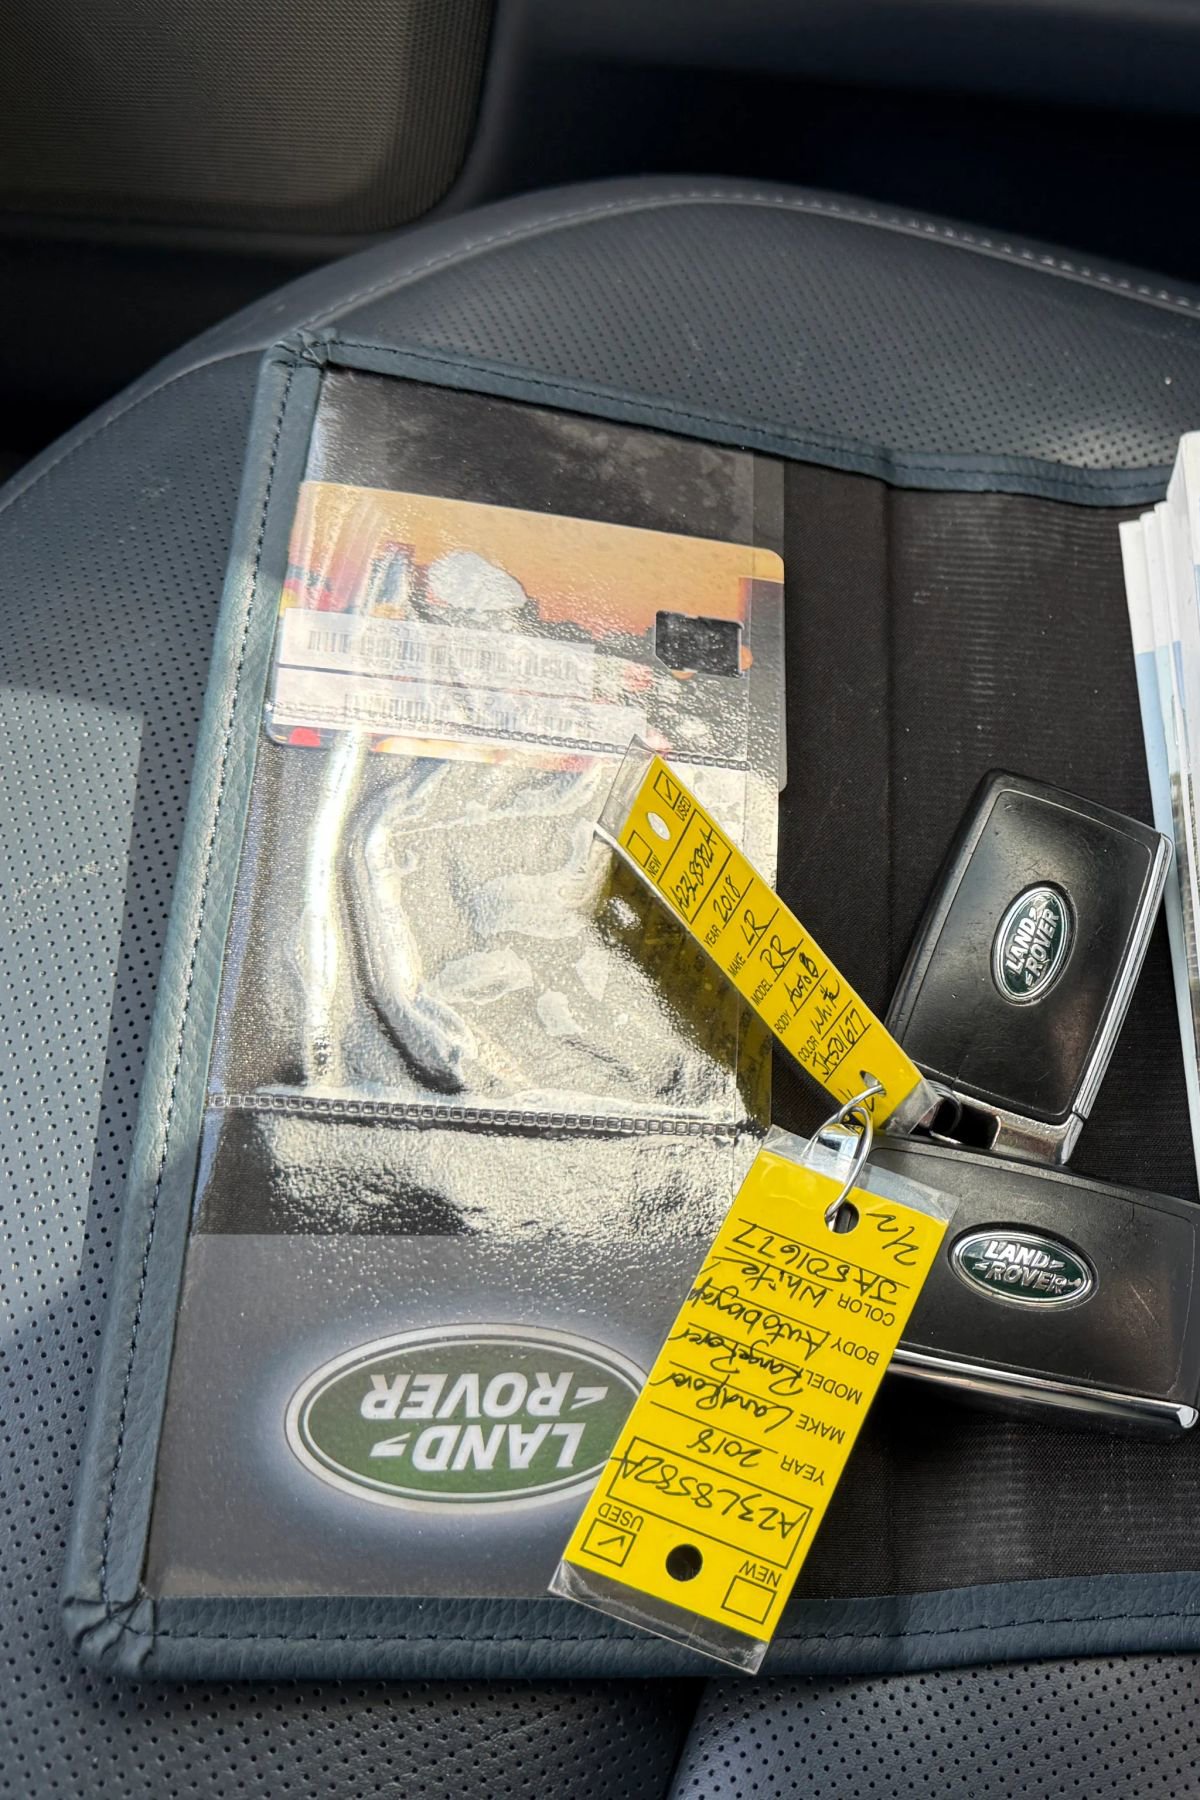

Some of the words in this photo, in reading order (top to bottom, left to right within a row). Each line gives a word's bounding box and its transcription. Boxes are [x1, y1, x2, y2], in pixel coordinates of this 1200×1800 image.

[648, 854, 662, 878] NEW
[675, 795, 692, 821] USED
[703, 924, 722, 949] YEAR
[713, 874, 741, 922] 2018
[726, 952, 747, 979] MAKE
[740, 909, 769, 946] LR
[760, 935, 797, 976] RR
[1005, 916, 1037, 975] LAND
[1025, 907, 1060, 977] ROVER
[750, 979, 774, 1007] MODEL
[774, 1009, 792, 1035] BODY
[798, 1035, 820, 1062] COLOR
[732, 1223, 897, 1305] JA501677
[984, 1240, 1051, 1269] LAND
[712, 1255, 828, 1308] White
[985, 1261, 1067, 1294] ROVER
[838, 1293, 895, 1327] COLOR
[830, 1336, 880, 1366] BODY
[360, 1371, 575, 1420] ROVER
[804, 1368, 863, 1405] MODEL
[411, 1422, 586, 1472] LAND
[686, 1428, 763, 1468] 2018
[795, 1413, 846, 1445] MAKE
[780, 1455, 825, 1485] YEAR
[610, 1451, 807, 1539] A23L8582A
[597, 1502, 645, 1532] USED
[738, 1560, 782, 1587] NEW
